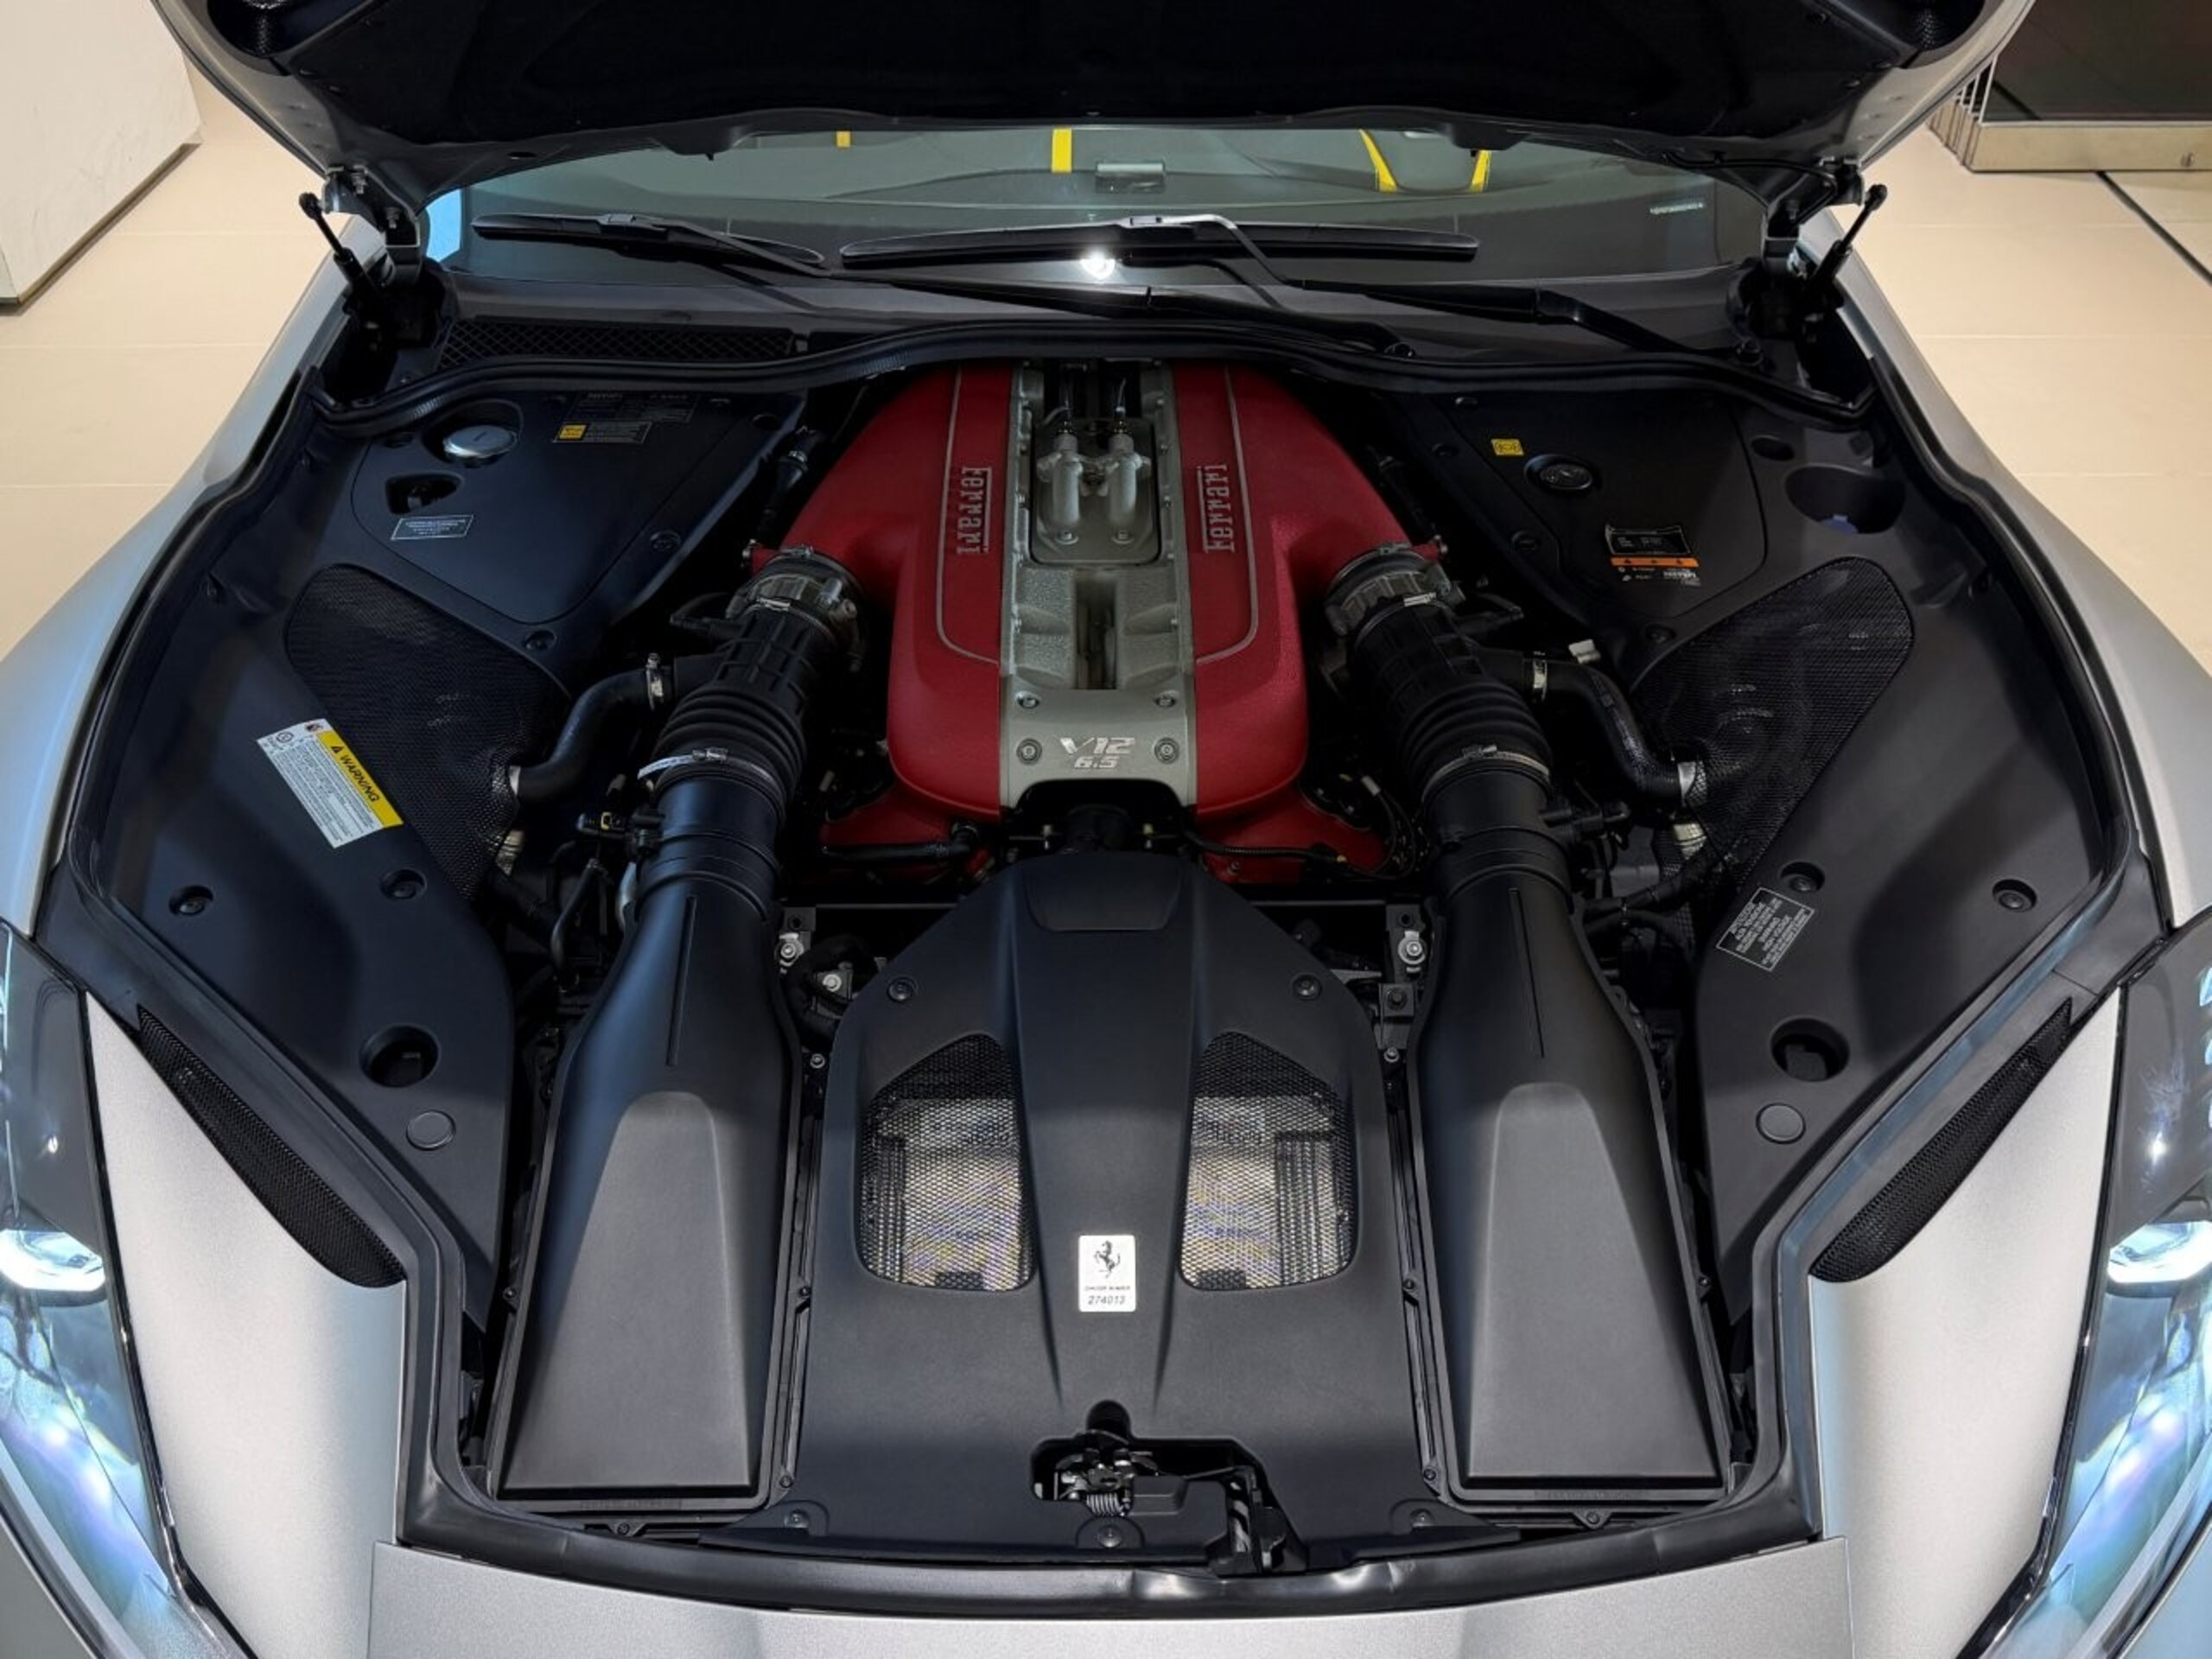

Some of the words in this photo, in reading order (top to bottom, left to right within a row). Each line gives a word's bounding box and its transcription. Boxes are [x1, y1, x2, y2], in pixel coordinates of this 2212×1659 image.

[957, 467, 992, 554] Ferrari
[1196, 464, 1236, 553] Ferrari
[1060, 737, 1135, 754] V12
[1074, 756, 1120, 768] 6.5
[340, 755, 379, 802] WARNING
